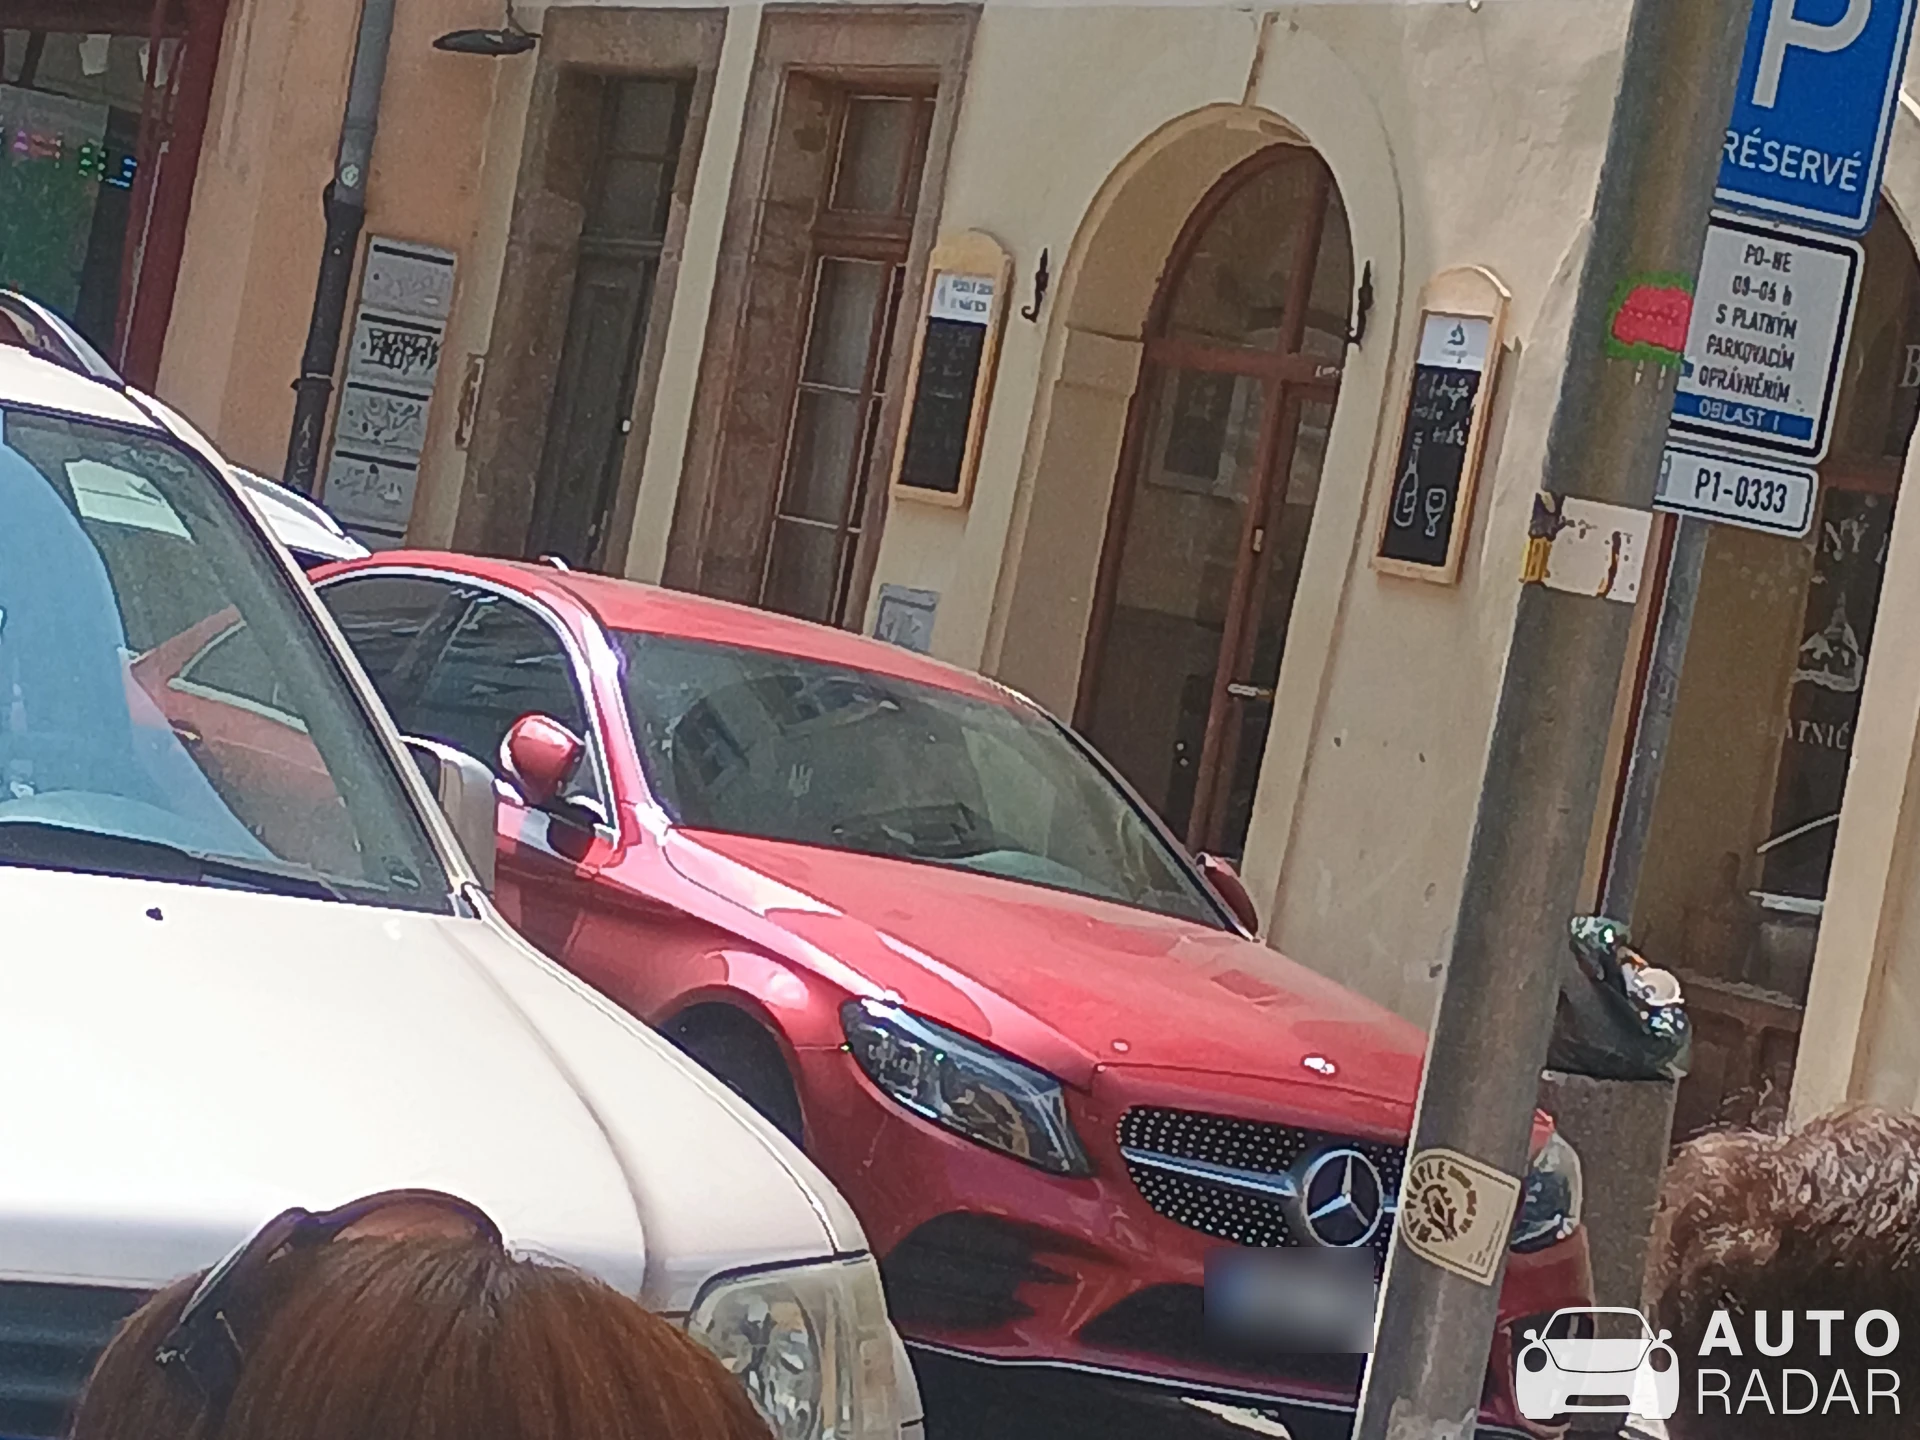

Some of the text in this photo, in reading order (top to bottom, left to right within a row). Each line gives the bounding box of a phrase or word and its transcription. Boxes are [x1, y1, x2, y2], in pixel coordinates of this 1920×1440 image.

[1751, 0, 1872, 109] P
[1723, 127, 1862, 192] RÉSERVÉ
[1715, 303, 1728, 324] S
[1731, 306, 1798, 340] PLATNÝM
[1706, 333, 1795, 372] PARKOVACÍM
[1699, 398, 1766, 427] OBLAST
[1694, 467, 1788, 514] P1-0333
